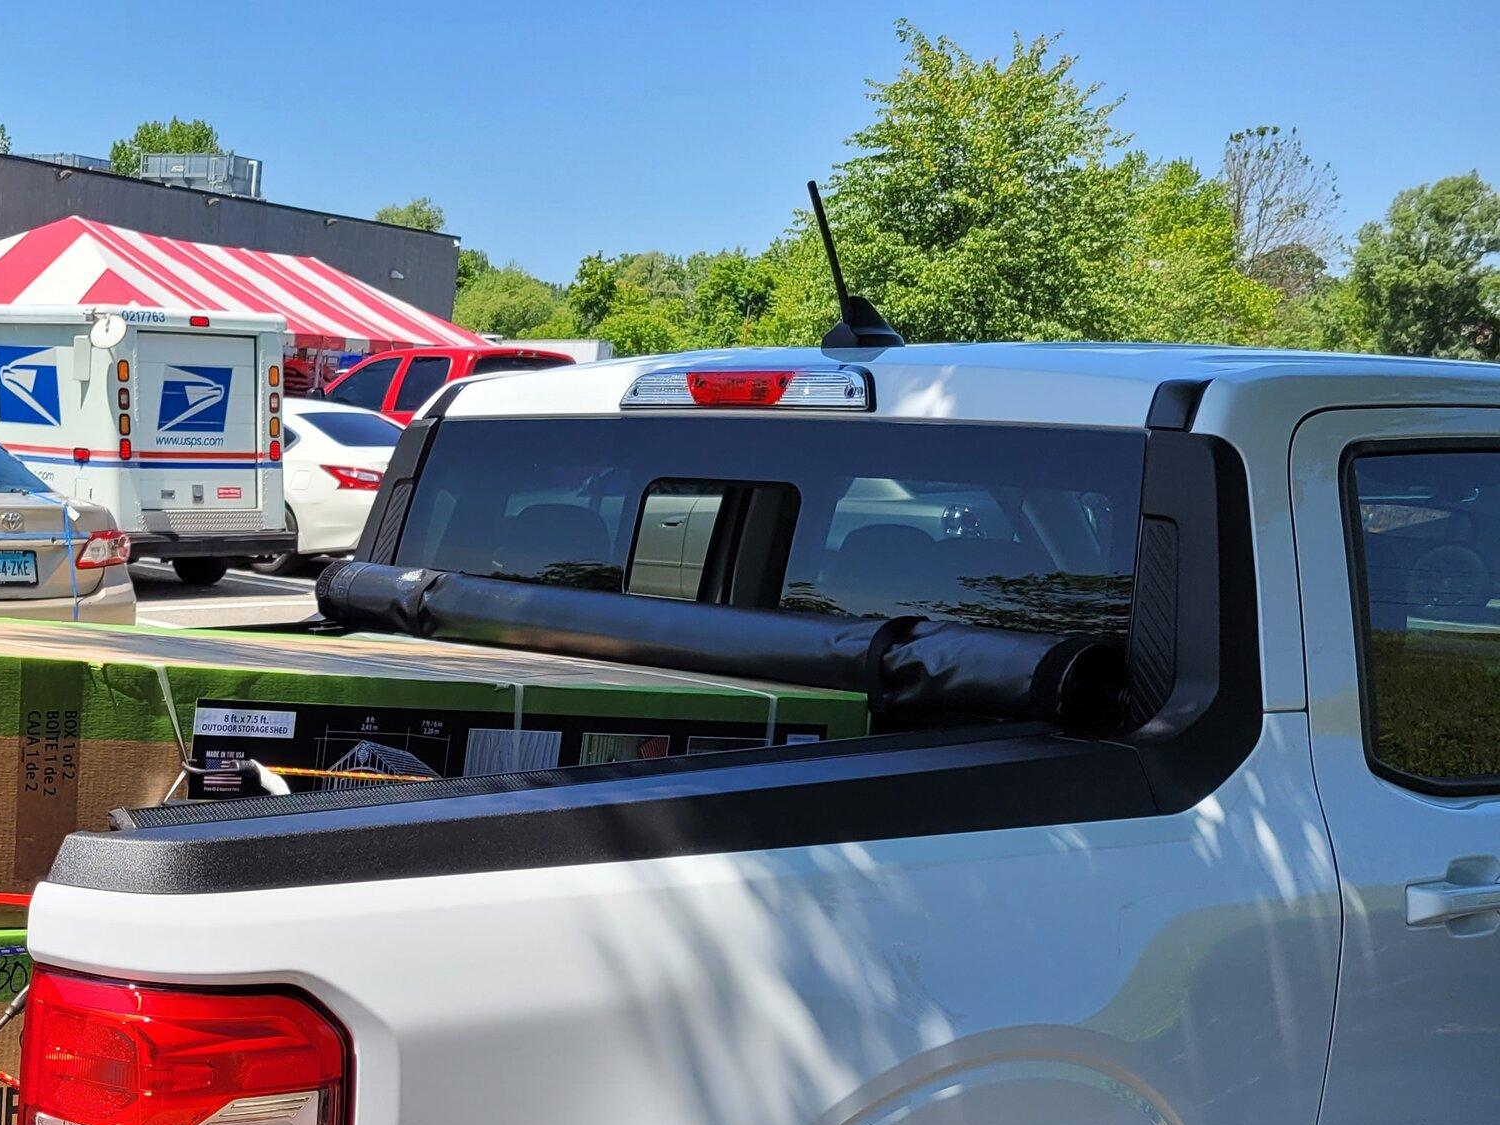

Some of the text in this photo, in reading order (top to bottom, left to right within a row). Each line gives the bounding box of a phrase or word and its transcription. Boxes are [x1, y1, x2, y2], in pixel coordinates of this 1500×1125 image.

[121, 311, 166, 322] 0217763
[155, 436, 224, 447] www.usps.com
[63, 709, 78, 739] BOX
[223, 714, 229, 723] 8
[230, 713, 240, 723] ft.
[246, 714, 259, 724] 7.5
[260, 714, 269, 724] ft.
[26, 710, 42, 747] CAJA
[201, 723, 288, 735] OUTDOOR STORAGE SHED
[205, 750, 220, 758] MADE
[62, 753, 76, 769] of
[25, 761, 39, 780] de
[43, 766, 58, 785] de
[62, 771, 75, 780] 2
[25, 783, 39, 792] 2
[43, 787, 57, 796] 2
